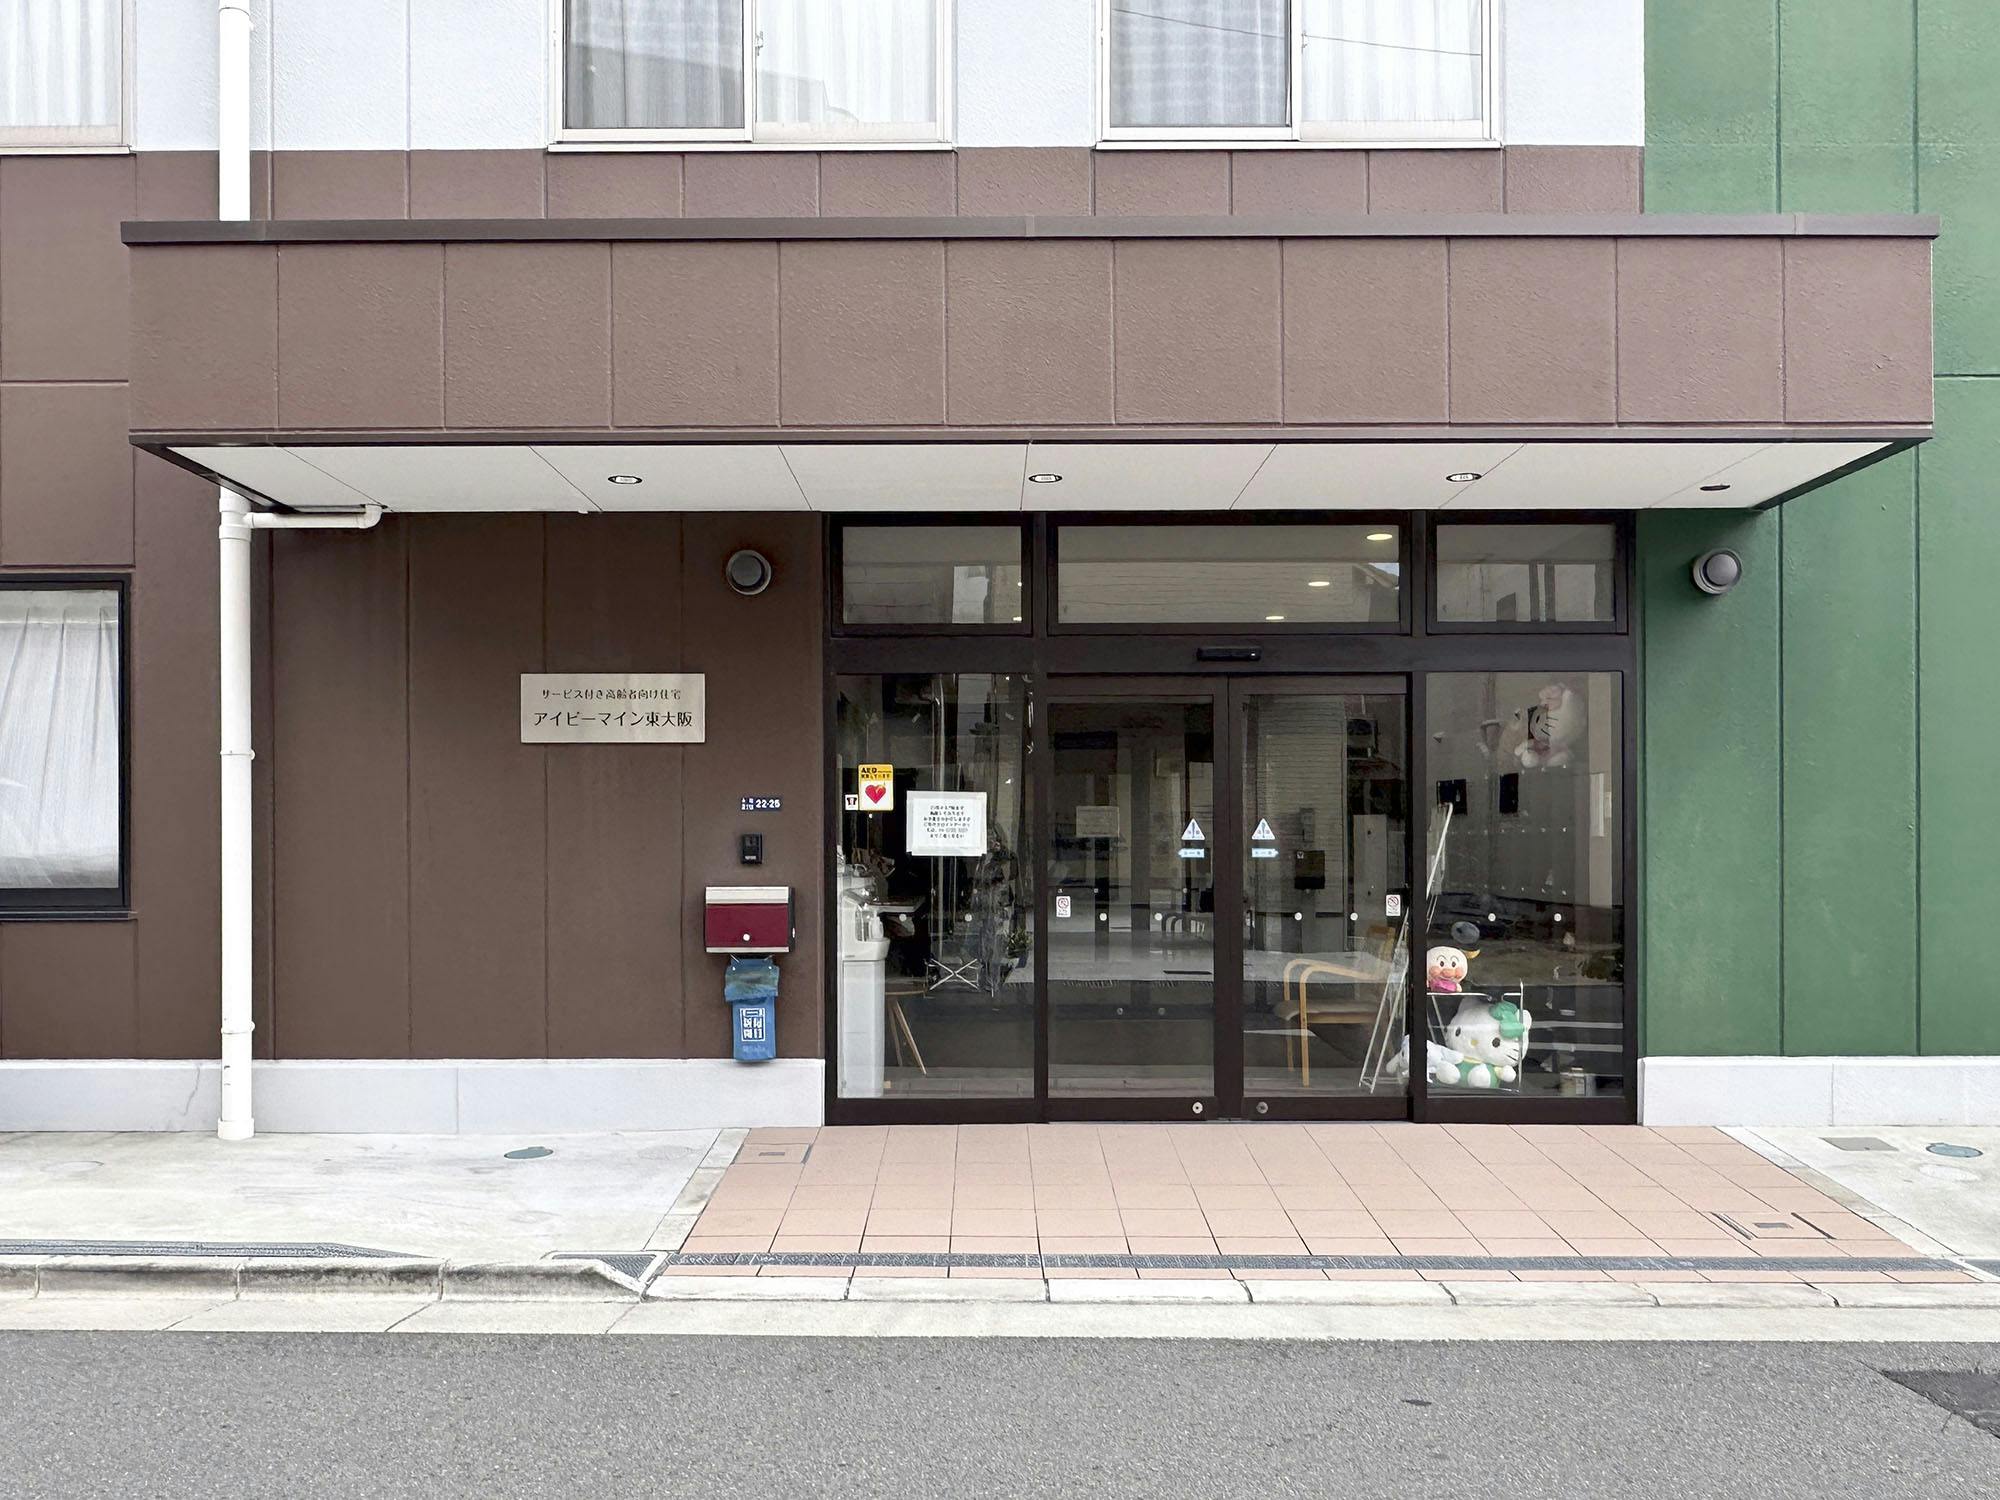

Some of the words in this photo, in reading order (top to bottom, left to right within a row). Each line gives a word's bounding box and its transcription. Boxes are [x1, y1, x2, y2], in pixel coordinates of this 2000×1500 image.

[542, 688, 681, 700] サービス付き高齢者向け住宅
[533, 711, 693, 727] アイビーマイン東大阪
